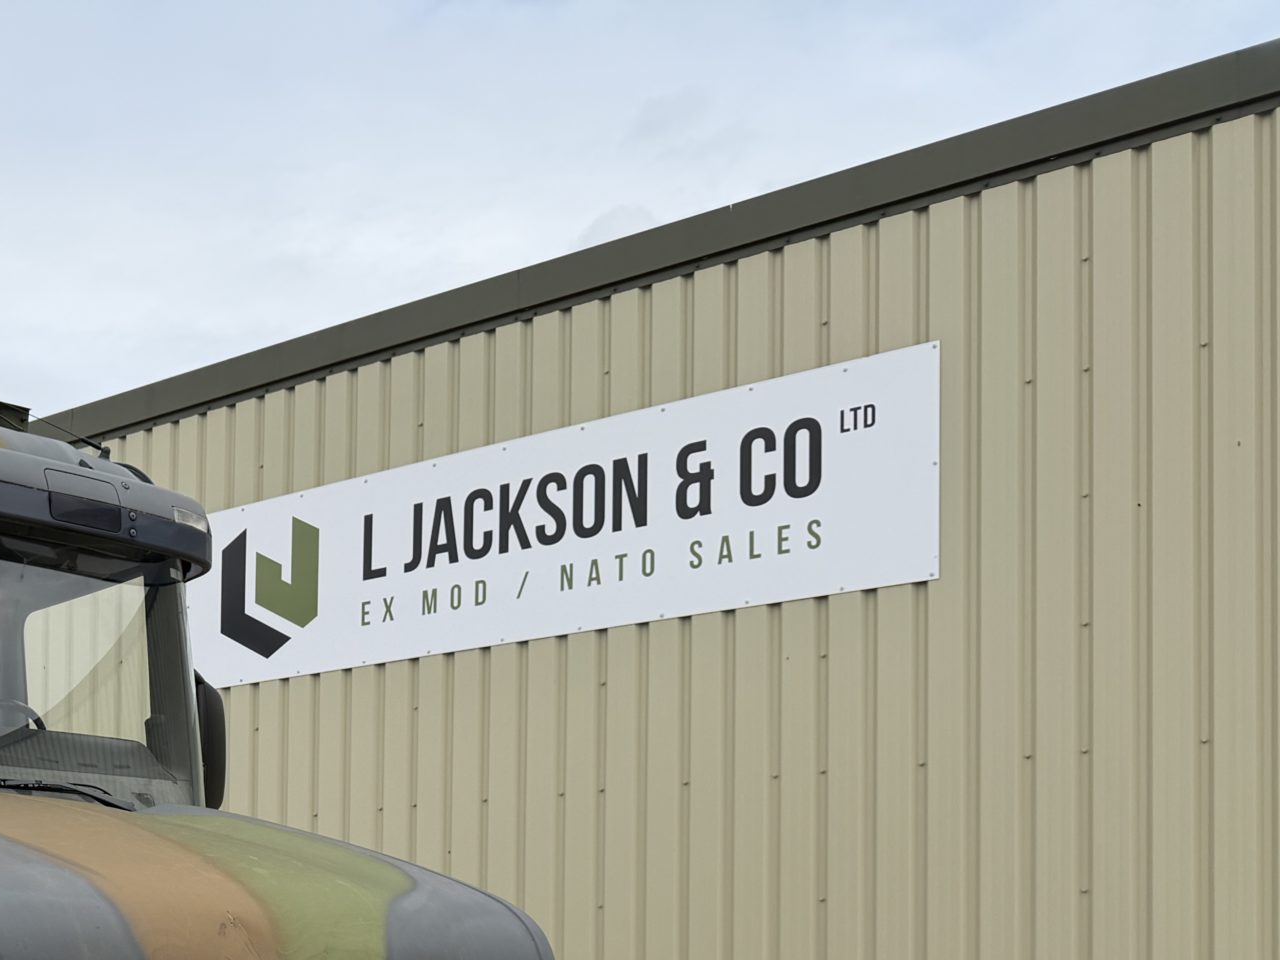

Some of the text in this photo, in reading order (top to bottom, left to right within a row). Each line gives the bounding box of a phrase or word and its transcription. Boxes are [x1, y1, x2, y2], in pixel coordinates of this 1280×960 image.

[362, 403, 877, 581] L JACKSON & CO LTD
[361, 596, 395, 627] EX
[421, 578, 488, 616] MOD
[559, 549, 655, 590] NATO
[688, 518, 823, 569] SALES
